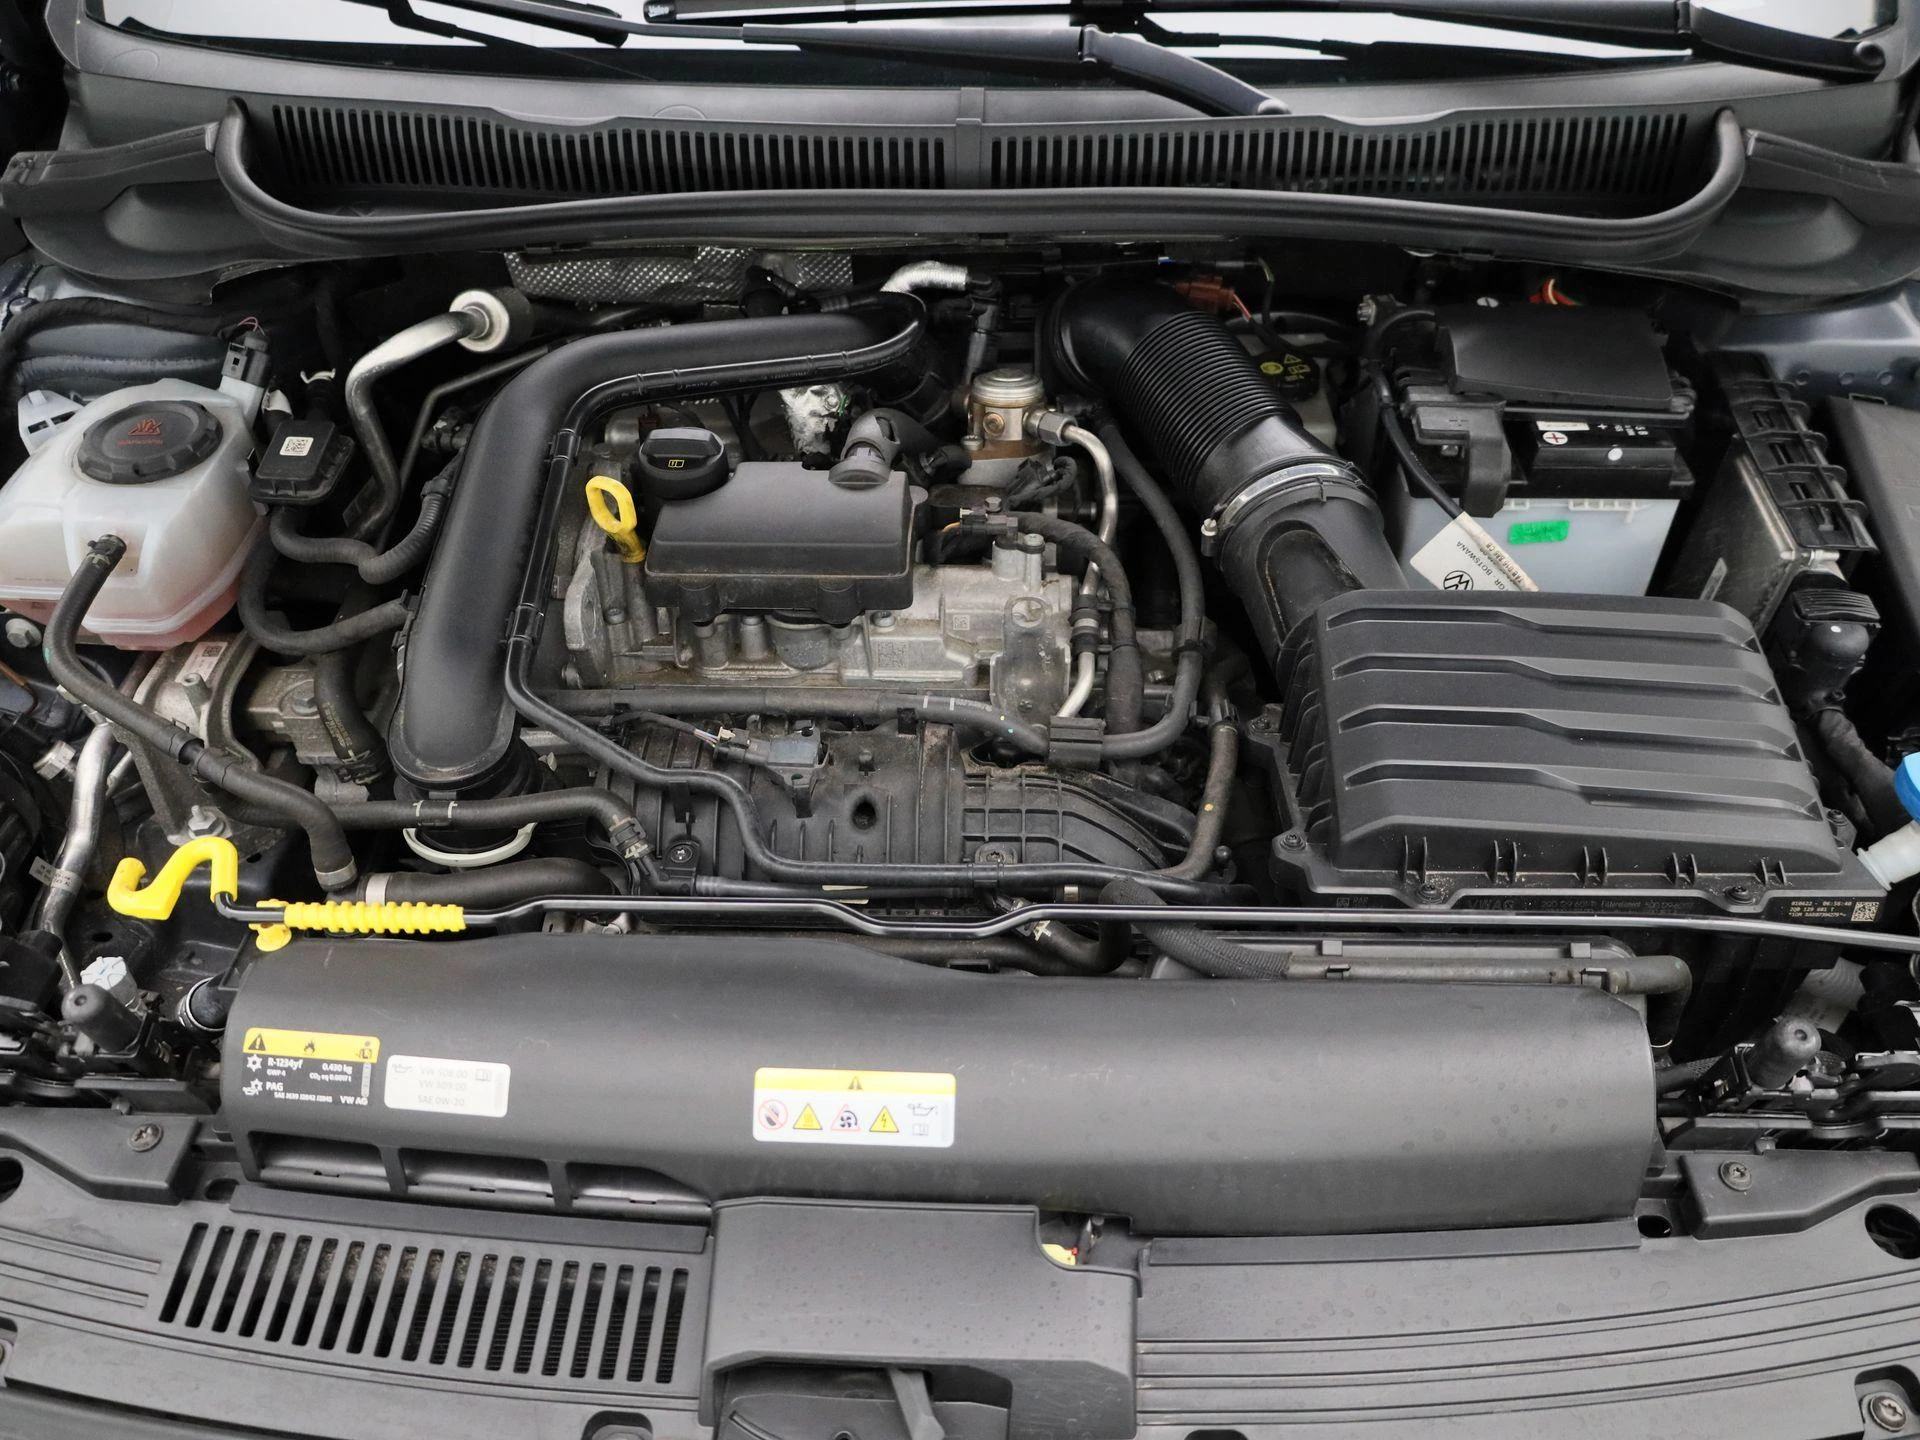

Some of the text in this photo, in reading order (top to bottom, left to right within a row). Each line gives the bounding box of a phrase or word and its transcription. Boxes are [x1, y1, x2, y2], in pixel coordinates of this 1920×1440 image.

[1456, 540, 1493, 576] BOTSWANA
[268, 1057, 303, 1070] R-1234yf
[343, 1064, 352, 1074] kg
[266, 1081, 284, 1092] PAG
[340, 1096, 355, 1104] VW
[355, 1097, 368, 1106] AG
